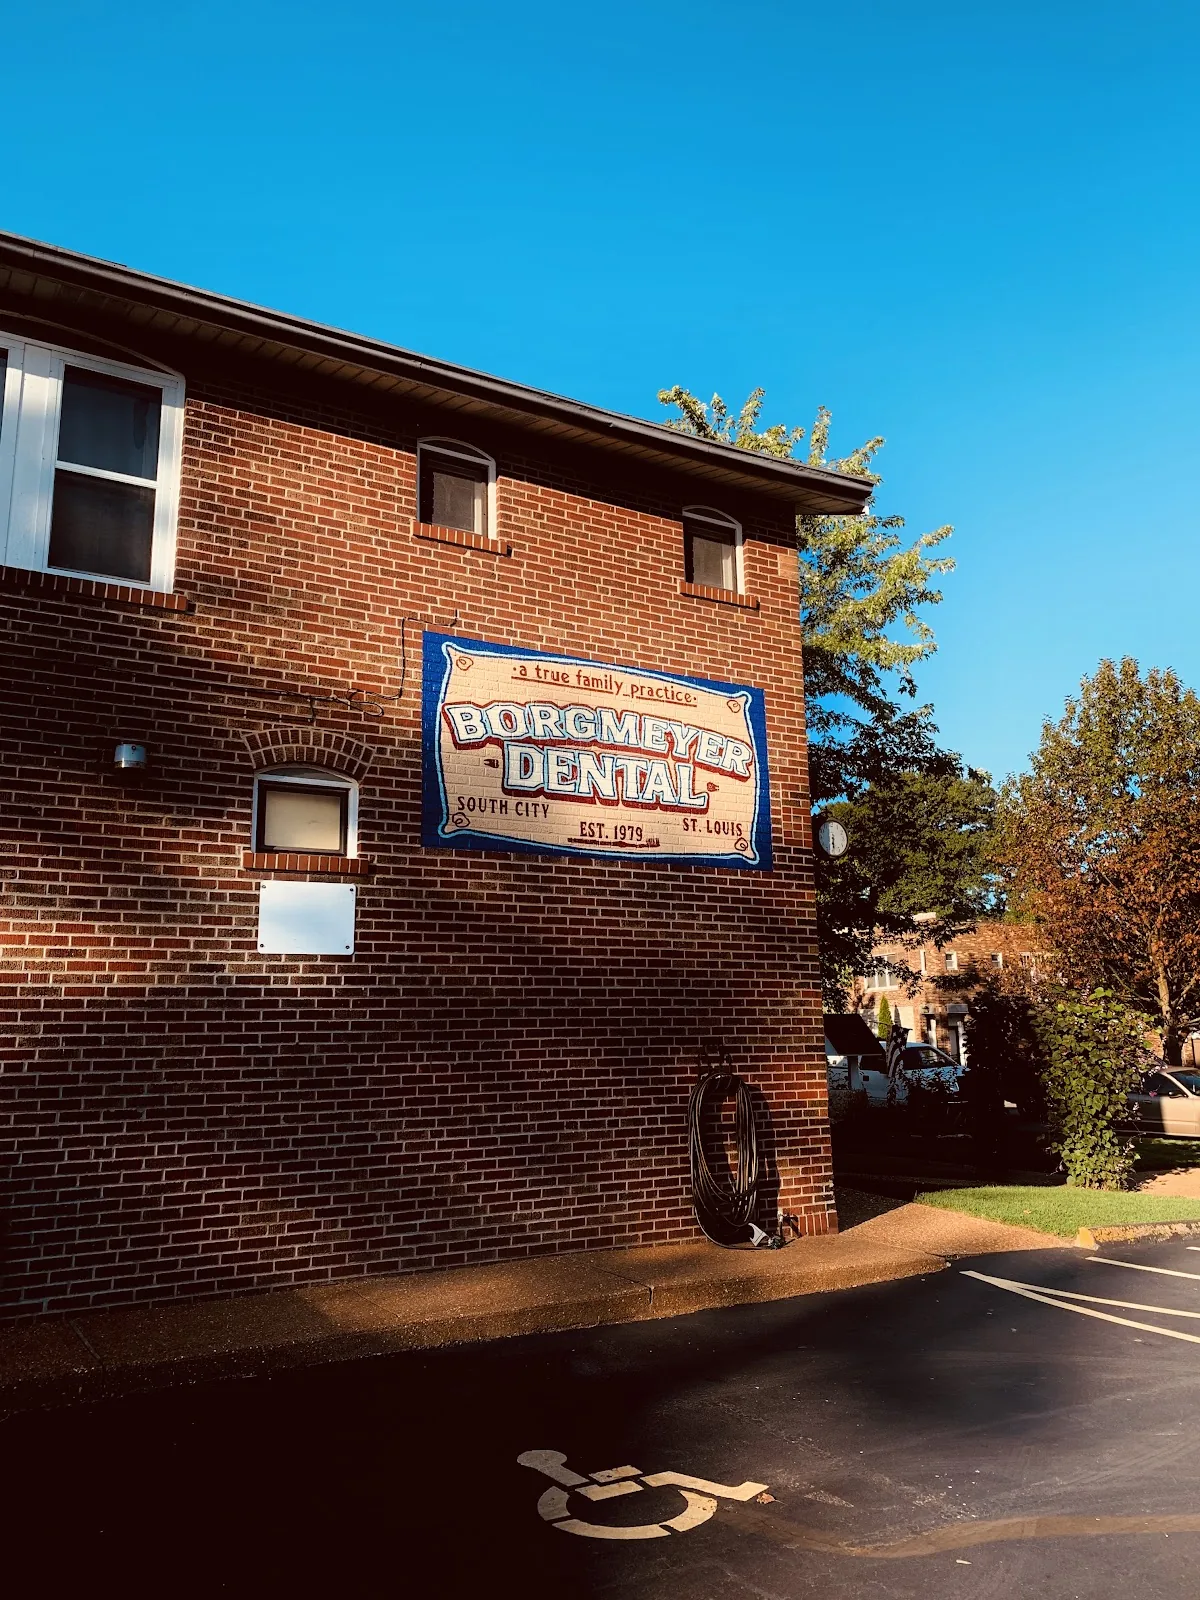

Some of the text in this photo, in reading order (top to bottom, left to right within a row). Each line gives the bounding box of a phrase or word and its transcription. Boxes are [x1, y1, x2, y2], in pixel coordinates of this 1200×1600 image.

[535, 664, 570, 683] true
[576, 669, 624, 696] family
[444, 702, 753, 779] BORGMEYER
[503, 740, 709, 808] DENTAL
[456, 796, 550, 819] SOUTH CITY
[579, 821, 643, 842] EST. 1979
[683, 817, 743, 837] ST. LOUIS
